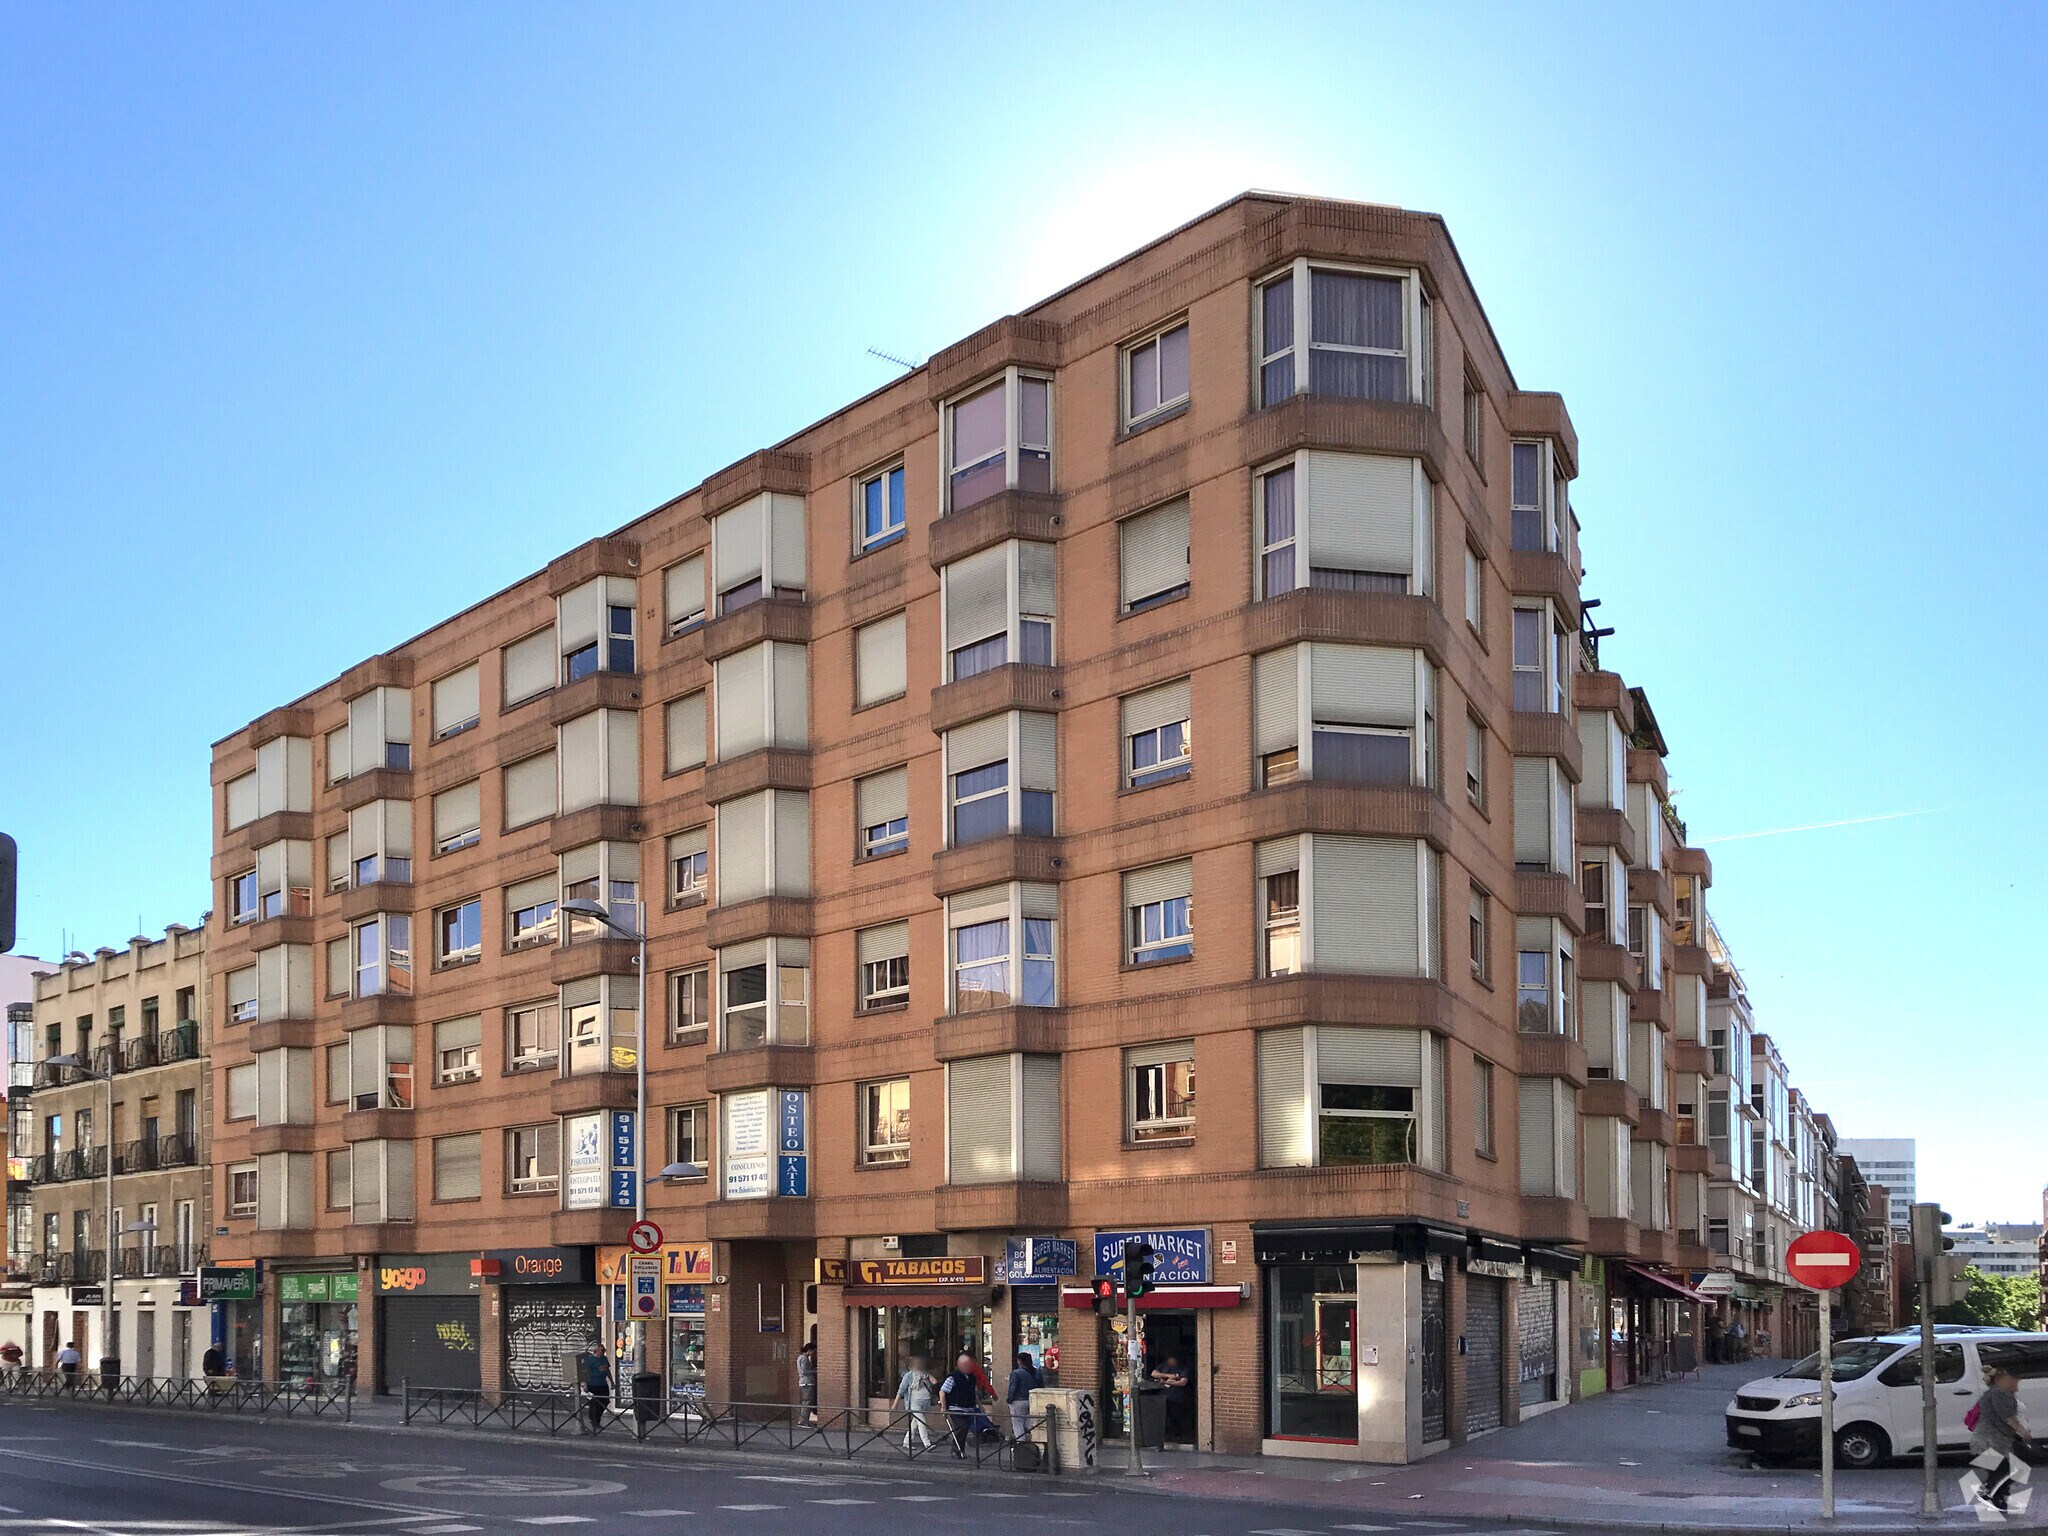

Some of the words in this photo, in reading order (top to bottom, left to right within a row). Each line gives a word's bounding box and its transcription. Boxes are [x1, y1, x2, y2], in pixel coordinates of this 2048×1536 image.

[570, 1175, 601, 1185] OSTEOPATI
[728, 1175, 737, 1184] 91
[738, 1174, 749, 1183] 571
[1102, 1235, 1142, 1263] SUP
[1148, 1233, 1202, 1260] MARKET
[515, 1255, 563, 1278] Orange
[667, 1251, 682, 1274] Tu
[886, 1259, 966, 1276] TABACOS
[380, 1267, 427, 1291] yoigo
[1104, 1267, 1201, 1281] INTACIÓN
[202, 1277, 251, 1291] PRIMAVERA
